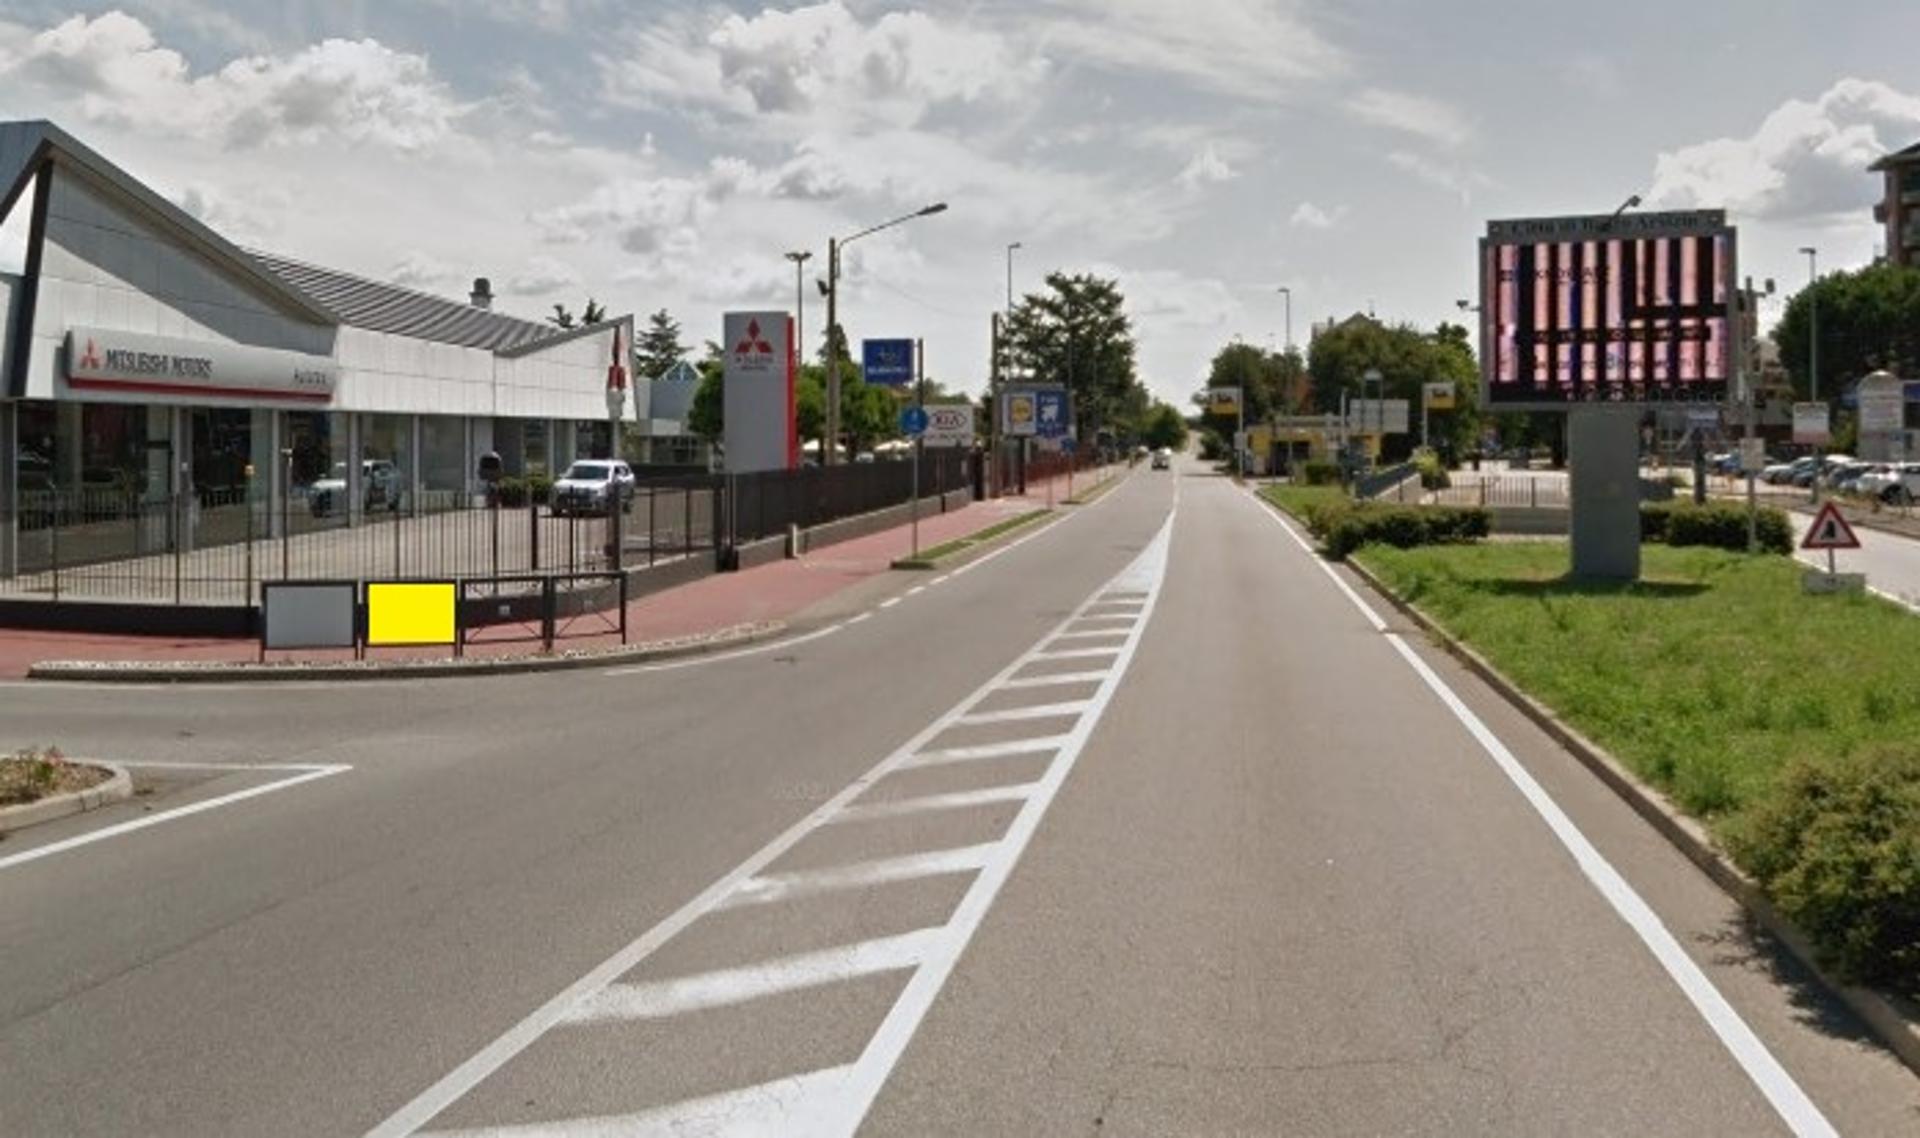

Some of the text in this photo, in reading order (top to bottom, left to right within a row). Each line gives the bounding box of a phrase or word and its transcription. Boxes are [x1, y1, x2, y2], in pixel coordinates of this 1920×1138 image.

[106, 349, 212, 378] MITSUBISHI MOTORS
[936, 415, 960, 425] KIA
